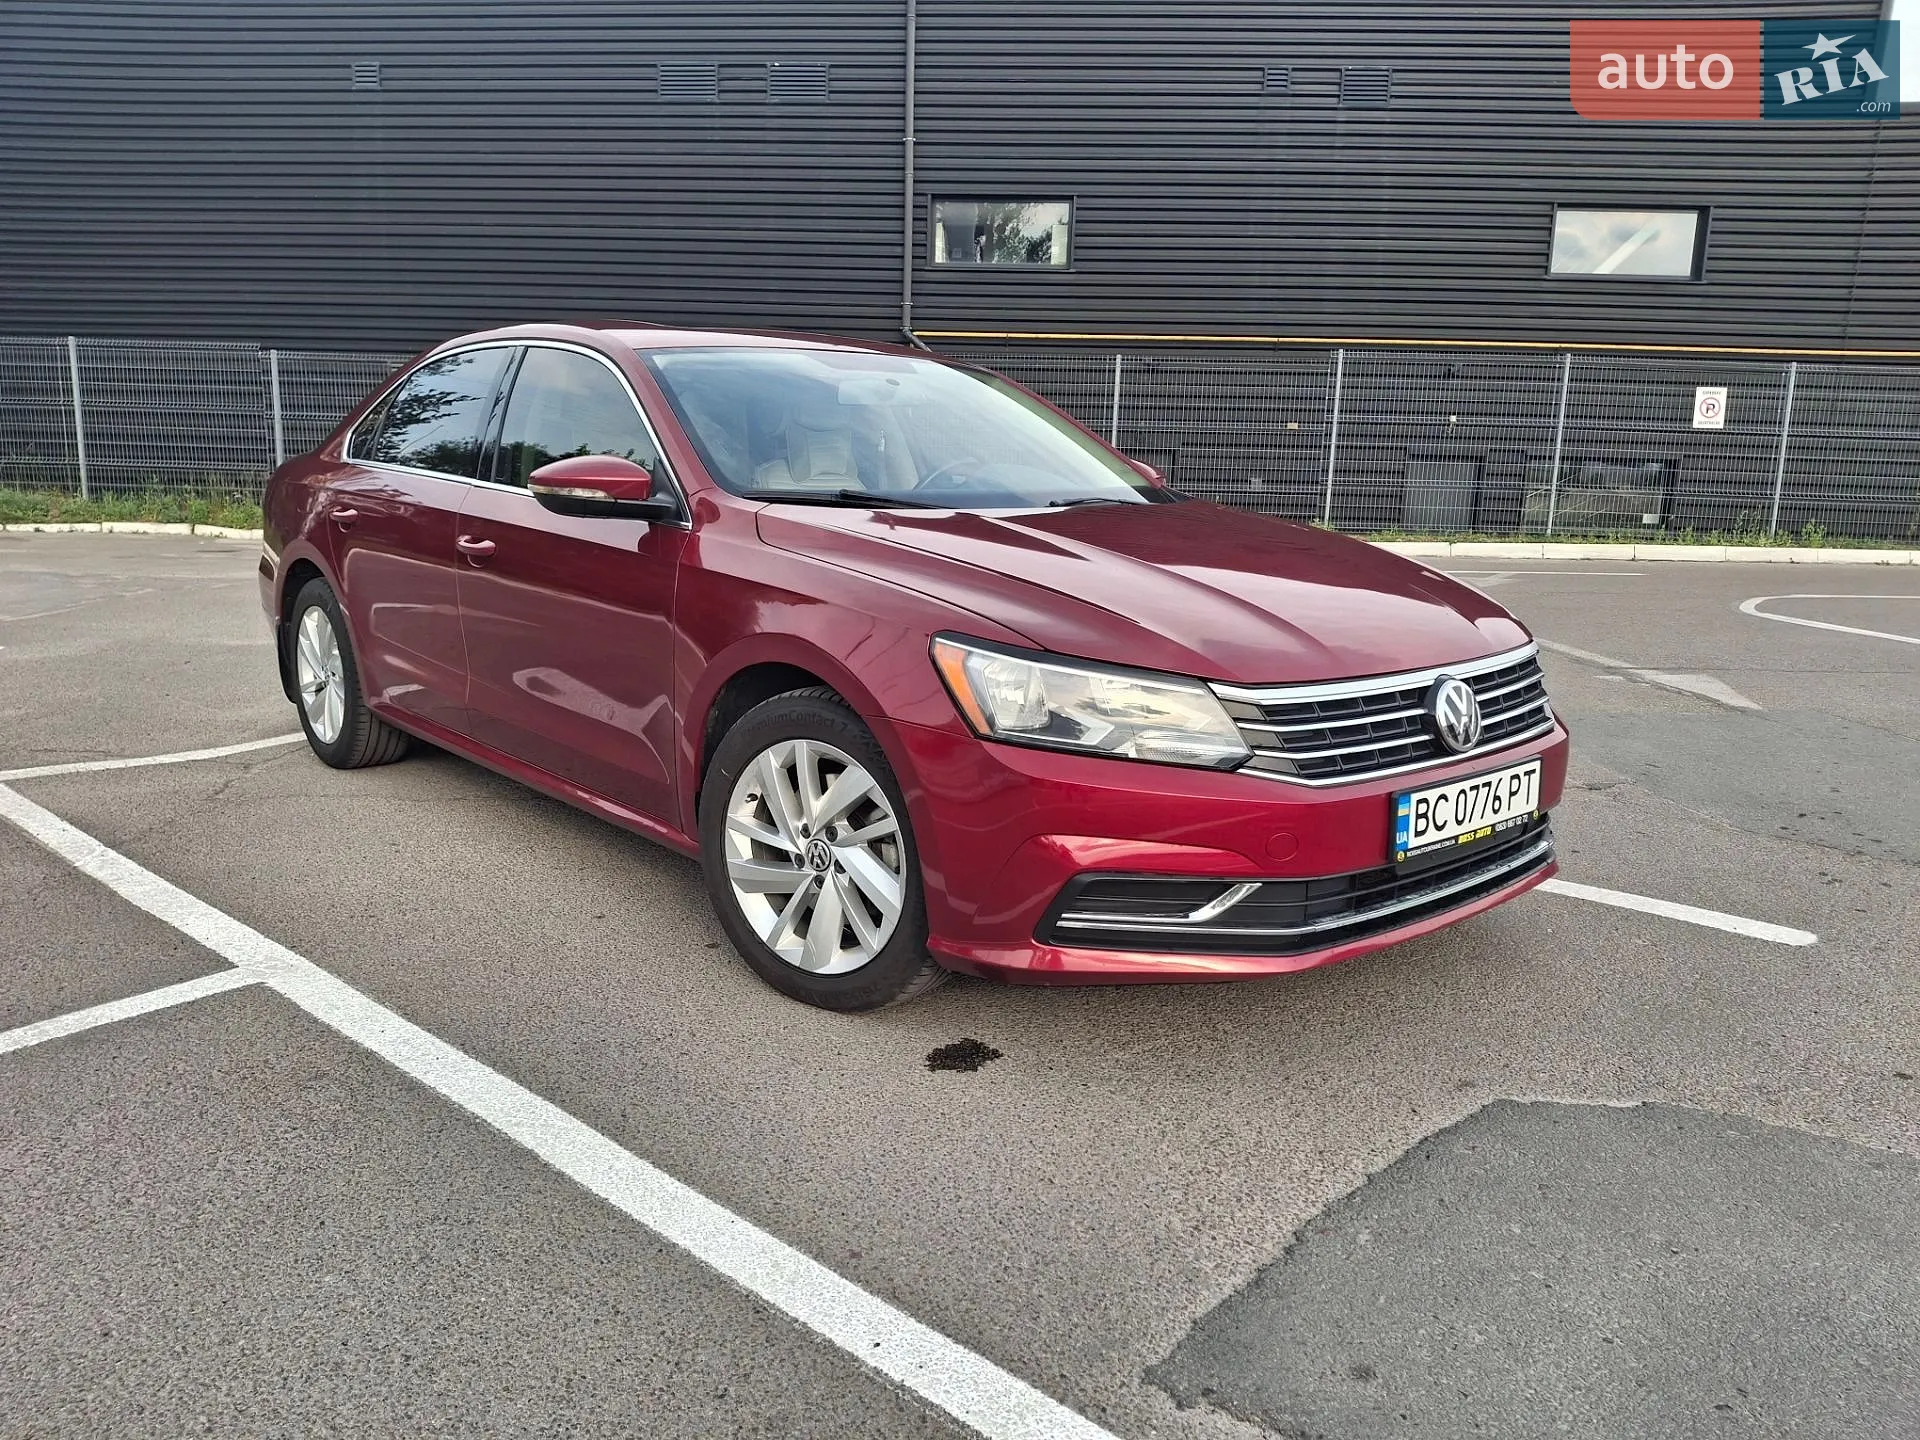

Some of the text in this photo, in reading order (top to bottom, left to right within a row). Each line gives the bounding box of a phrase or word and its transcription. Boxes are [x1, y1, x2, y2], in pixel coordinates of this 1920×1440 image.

[1414, 768, 1537, 838] BC 0776 PT
[1396, 831, 1408, 844] UA
